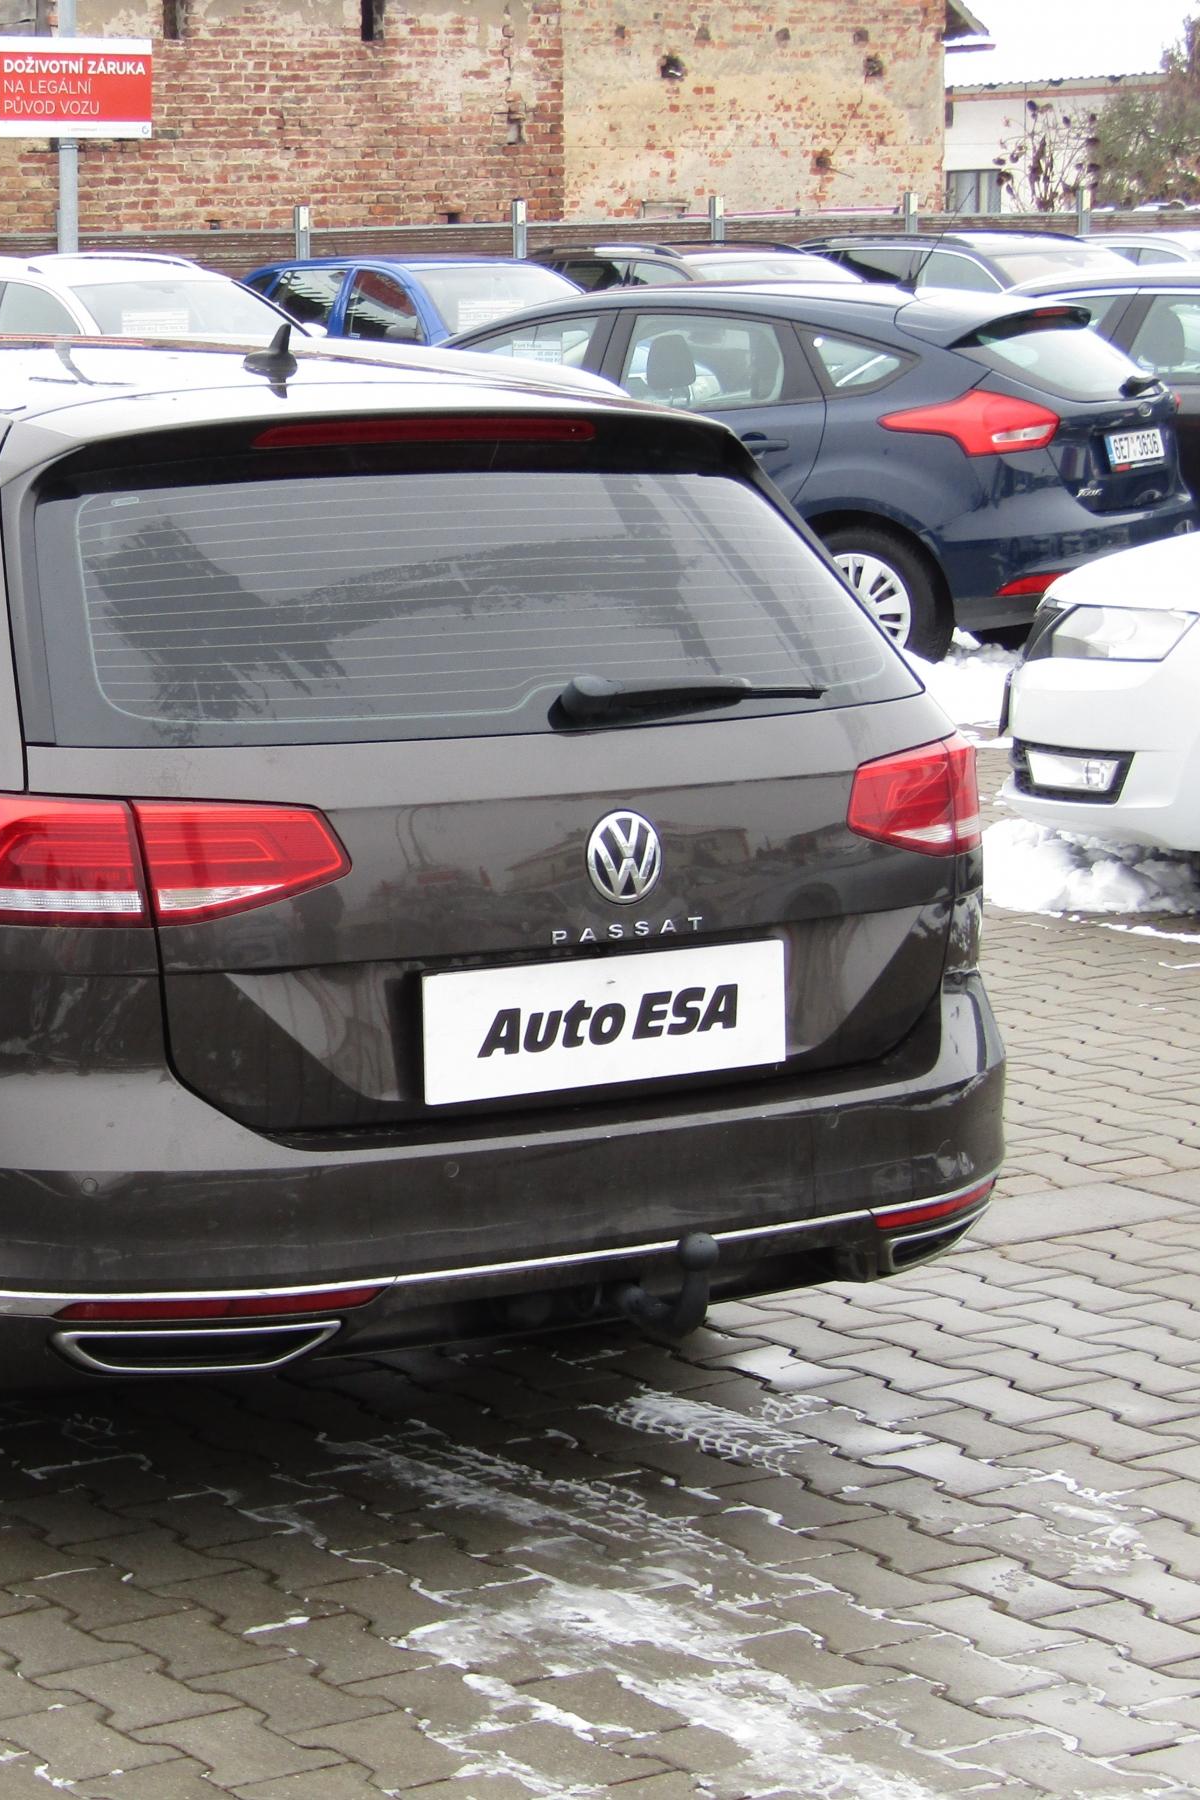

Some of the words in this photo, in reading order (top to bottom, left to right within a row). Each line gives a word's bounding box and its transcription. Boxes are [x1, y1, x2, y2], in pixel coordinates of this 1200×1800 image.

[3, 56, 83, 74] DOŽIVOTNÍ
[87, 58, 146, 75] ZÁRUKA
[3, 80, 25, 93] NA
[29, 78, 92, 94] LEGÁLNÍ
[3, 96, 56, 114] PŮVOD
[60, 101, 100, 115] VOZU
[552, 916, 703, 945] PASSAT
[477, 999, 626, 1059] Auto
[632, 983, 739, 1041] ESA
